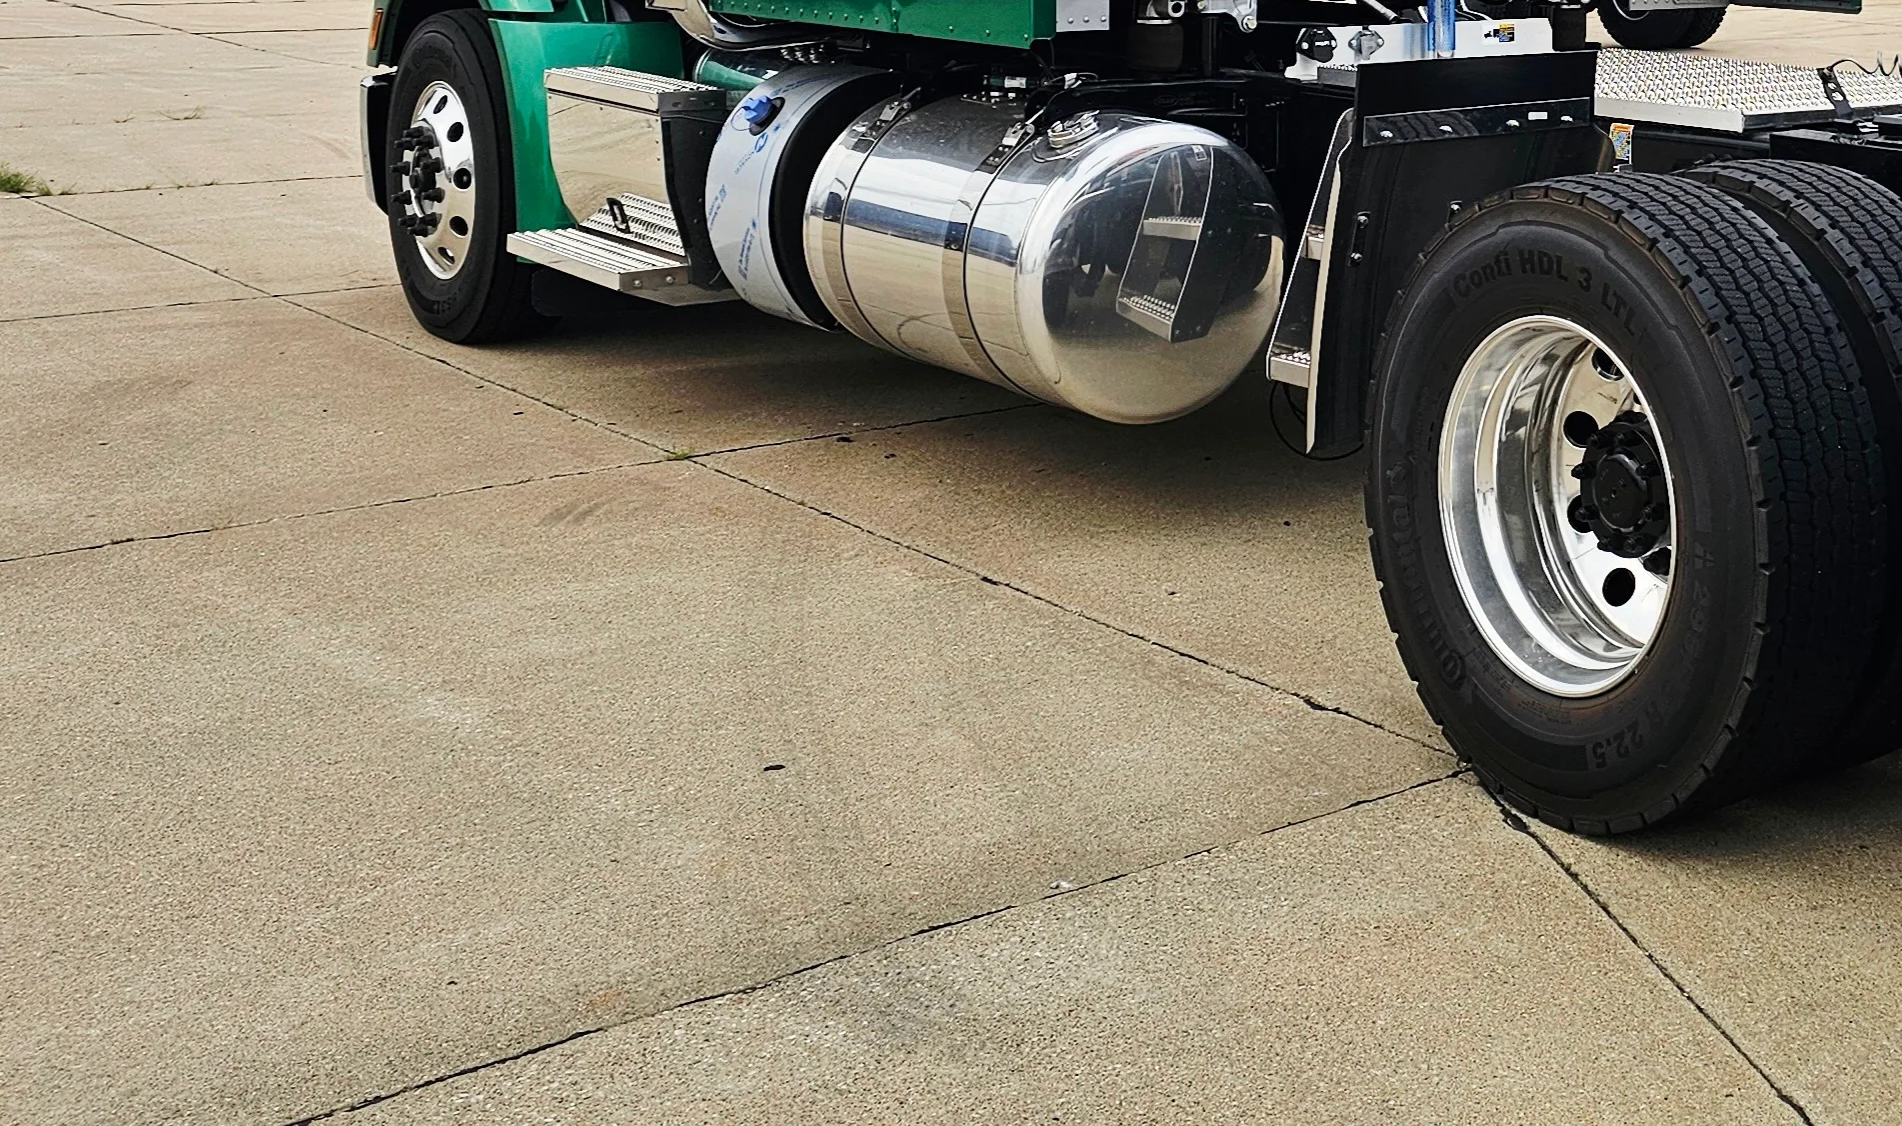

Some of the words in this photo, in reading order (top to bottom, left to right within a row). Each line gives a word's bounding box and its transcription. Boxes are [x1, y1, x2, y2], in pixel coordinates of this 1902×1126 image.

[1452, 250, 1513, 298] Conti
[1518, 249, 1569, 282] HDL
[1577, 267, 1593, 292] 3
[1600, 282, 1637, 336] LTL
